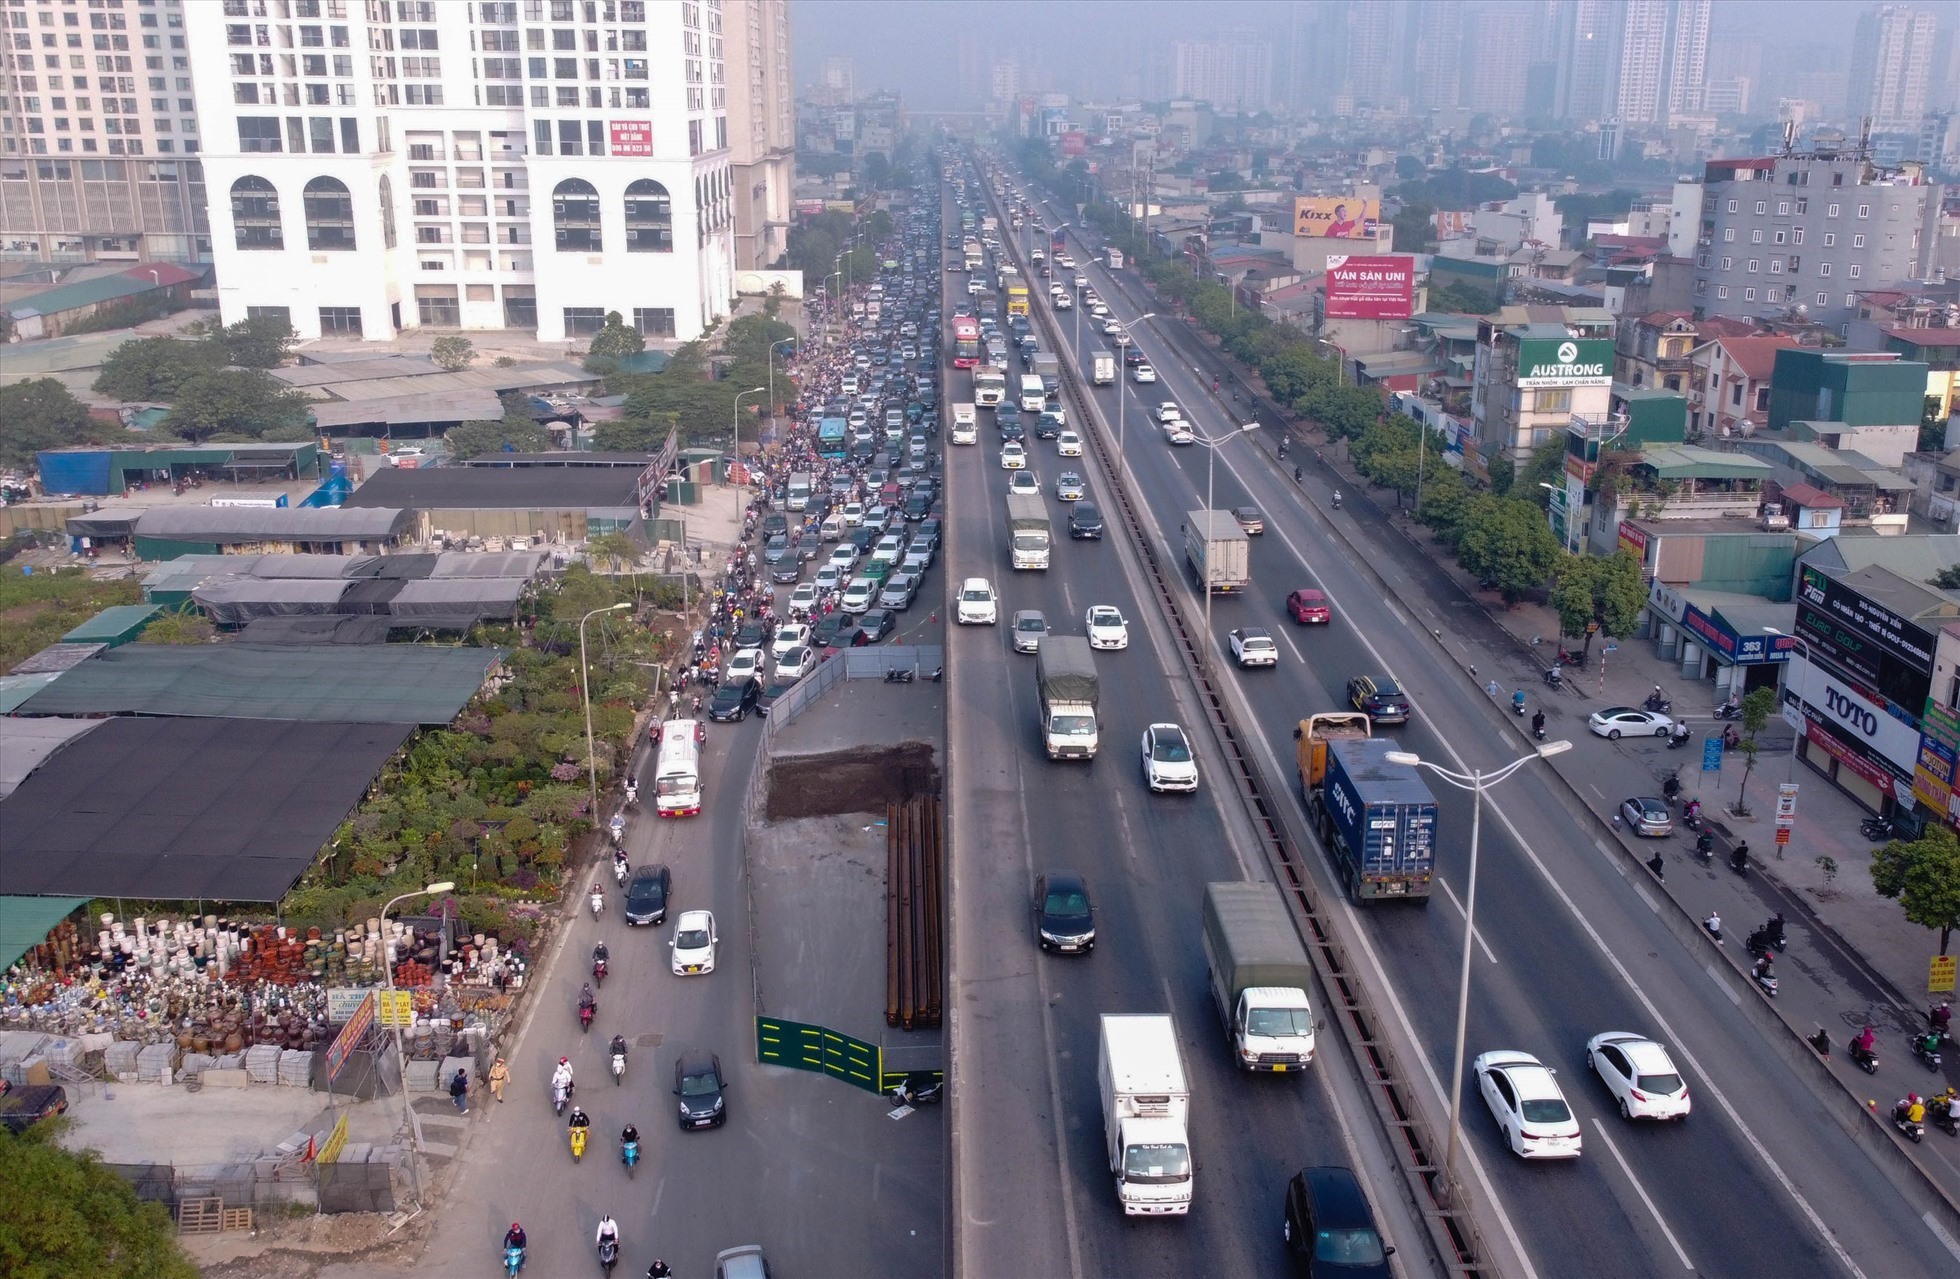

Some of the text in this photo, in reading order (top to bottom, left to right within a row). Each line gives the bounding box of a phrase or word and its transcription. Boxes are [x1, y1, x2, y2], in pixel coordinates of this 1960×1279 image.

[1299, 209, 1333, 220] Kixx
[1333, 270, 1405, 281] VÁN SÀN UNI
[1530, 364, 1603, 376] AUSTRONG
[1806, 612, 1831, 634] EURO
[1835, 630, 1862, 653] GOLF
[1743, 642, 1761, 652] 363
[1826, 685, 1877, 736] TOTO
[1928, 756, 1950, 777] JOTUN
